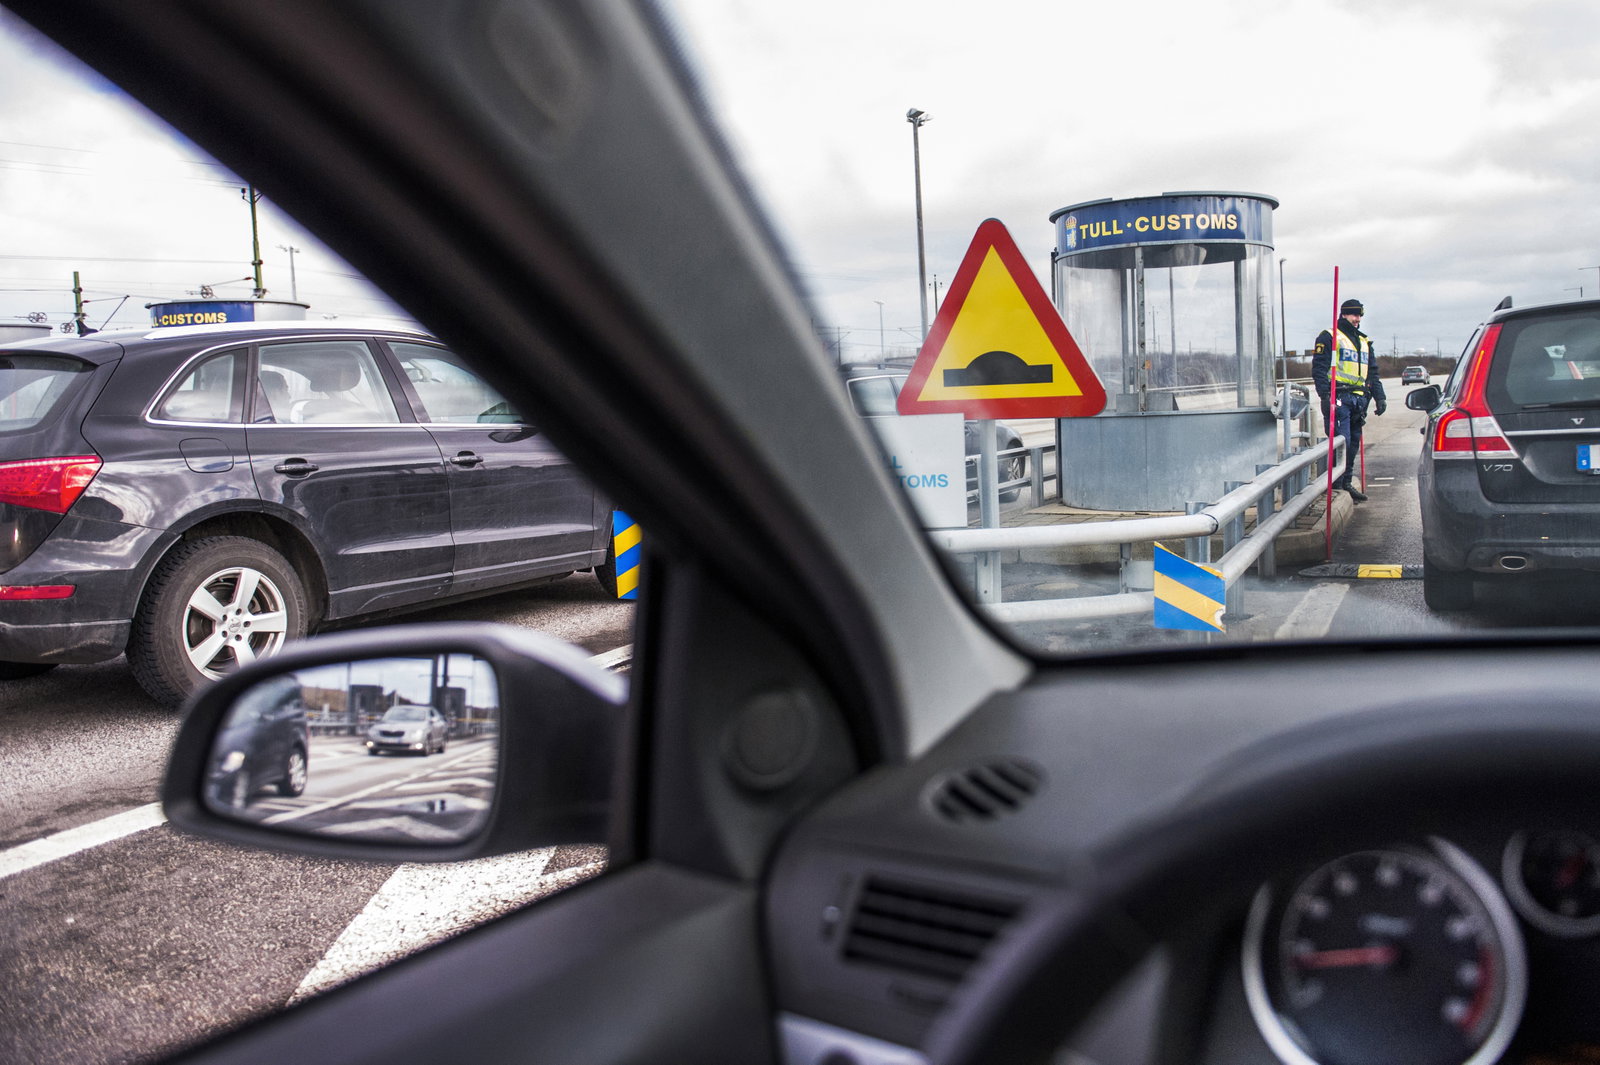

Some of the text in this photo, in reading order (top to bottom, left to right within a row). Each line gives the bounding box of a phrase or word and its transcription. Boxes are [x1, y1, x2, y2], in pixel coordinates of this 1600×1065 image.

[1080, 214, 1238, 239] TULL CUSTOMS
[162, 312, 227, 325] CUSTOMS
[1483, 464, 1514, 472] V70
[896, 473, 949, 489] TOMS
